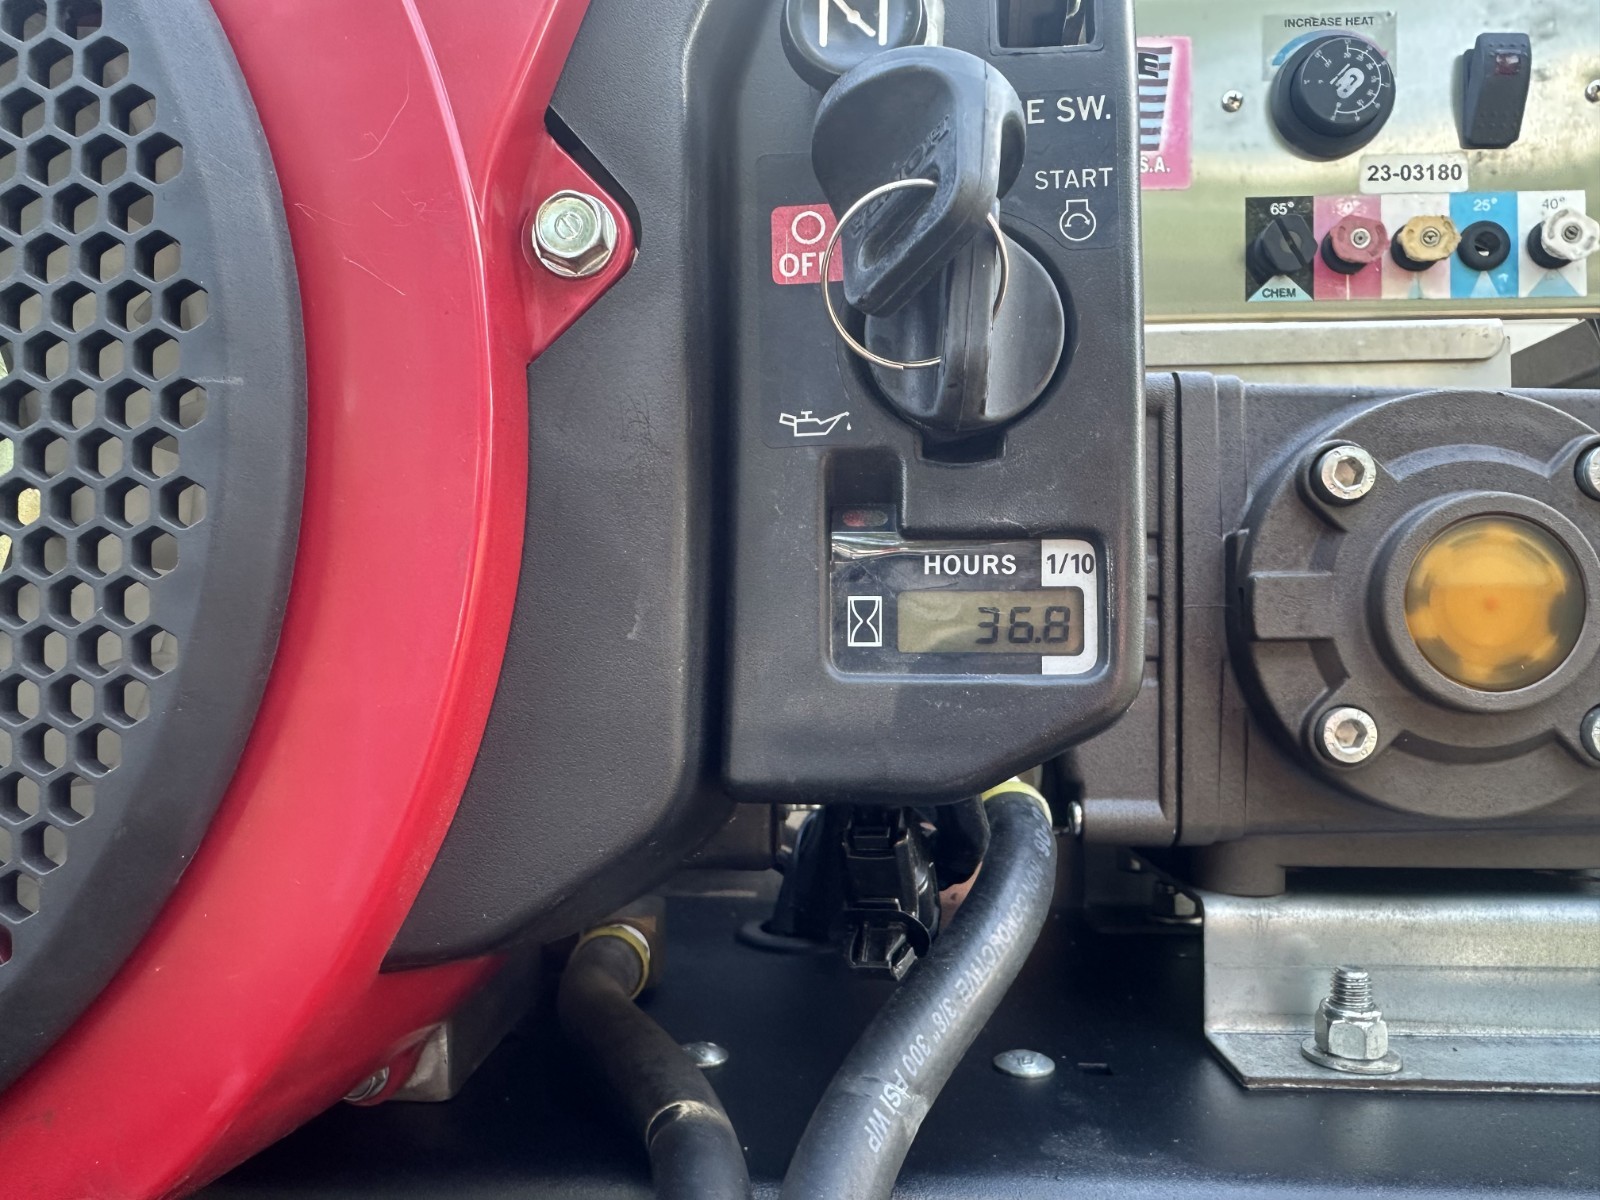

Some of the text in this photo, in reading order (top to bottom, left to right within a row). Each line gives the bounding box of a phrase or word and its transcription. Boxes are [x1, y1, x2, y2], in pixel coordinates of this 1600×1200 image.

[1284, 16, 1374, 27] INCREASE HEAT
[1138, 52, 1159, 78] E
[1027, 94, 1111, 124] E SW.
[1140, 156, 1171, 173] S.A.
[1367, 164, 1462, 181] 23-03180
[1034, 167, 1114, 190] START
[1270, 201, 1295, 216] 65°
[1473, 197, 1498, 211] 25°
[1542, 197, 1565, 209] 40°
[1262, 287, 1297, 298] CHEM
[923, 554, 1017, 575] HOURS
[1046, 553, 1095, 574] 1/10
[975, 606, 1071, 644] 36.8
[931, 998, 958, 1044] 3/8"
[902, 1034, 932, 1077] 300
[879, 1068, 909, 1115] PSI
[864, 1107, 891, 1153] WP
